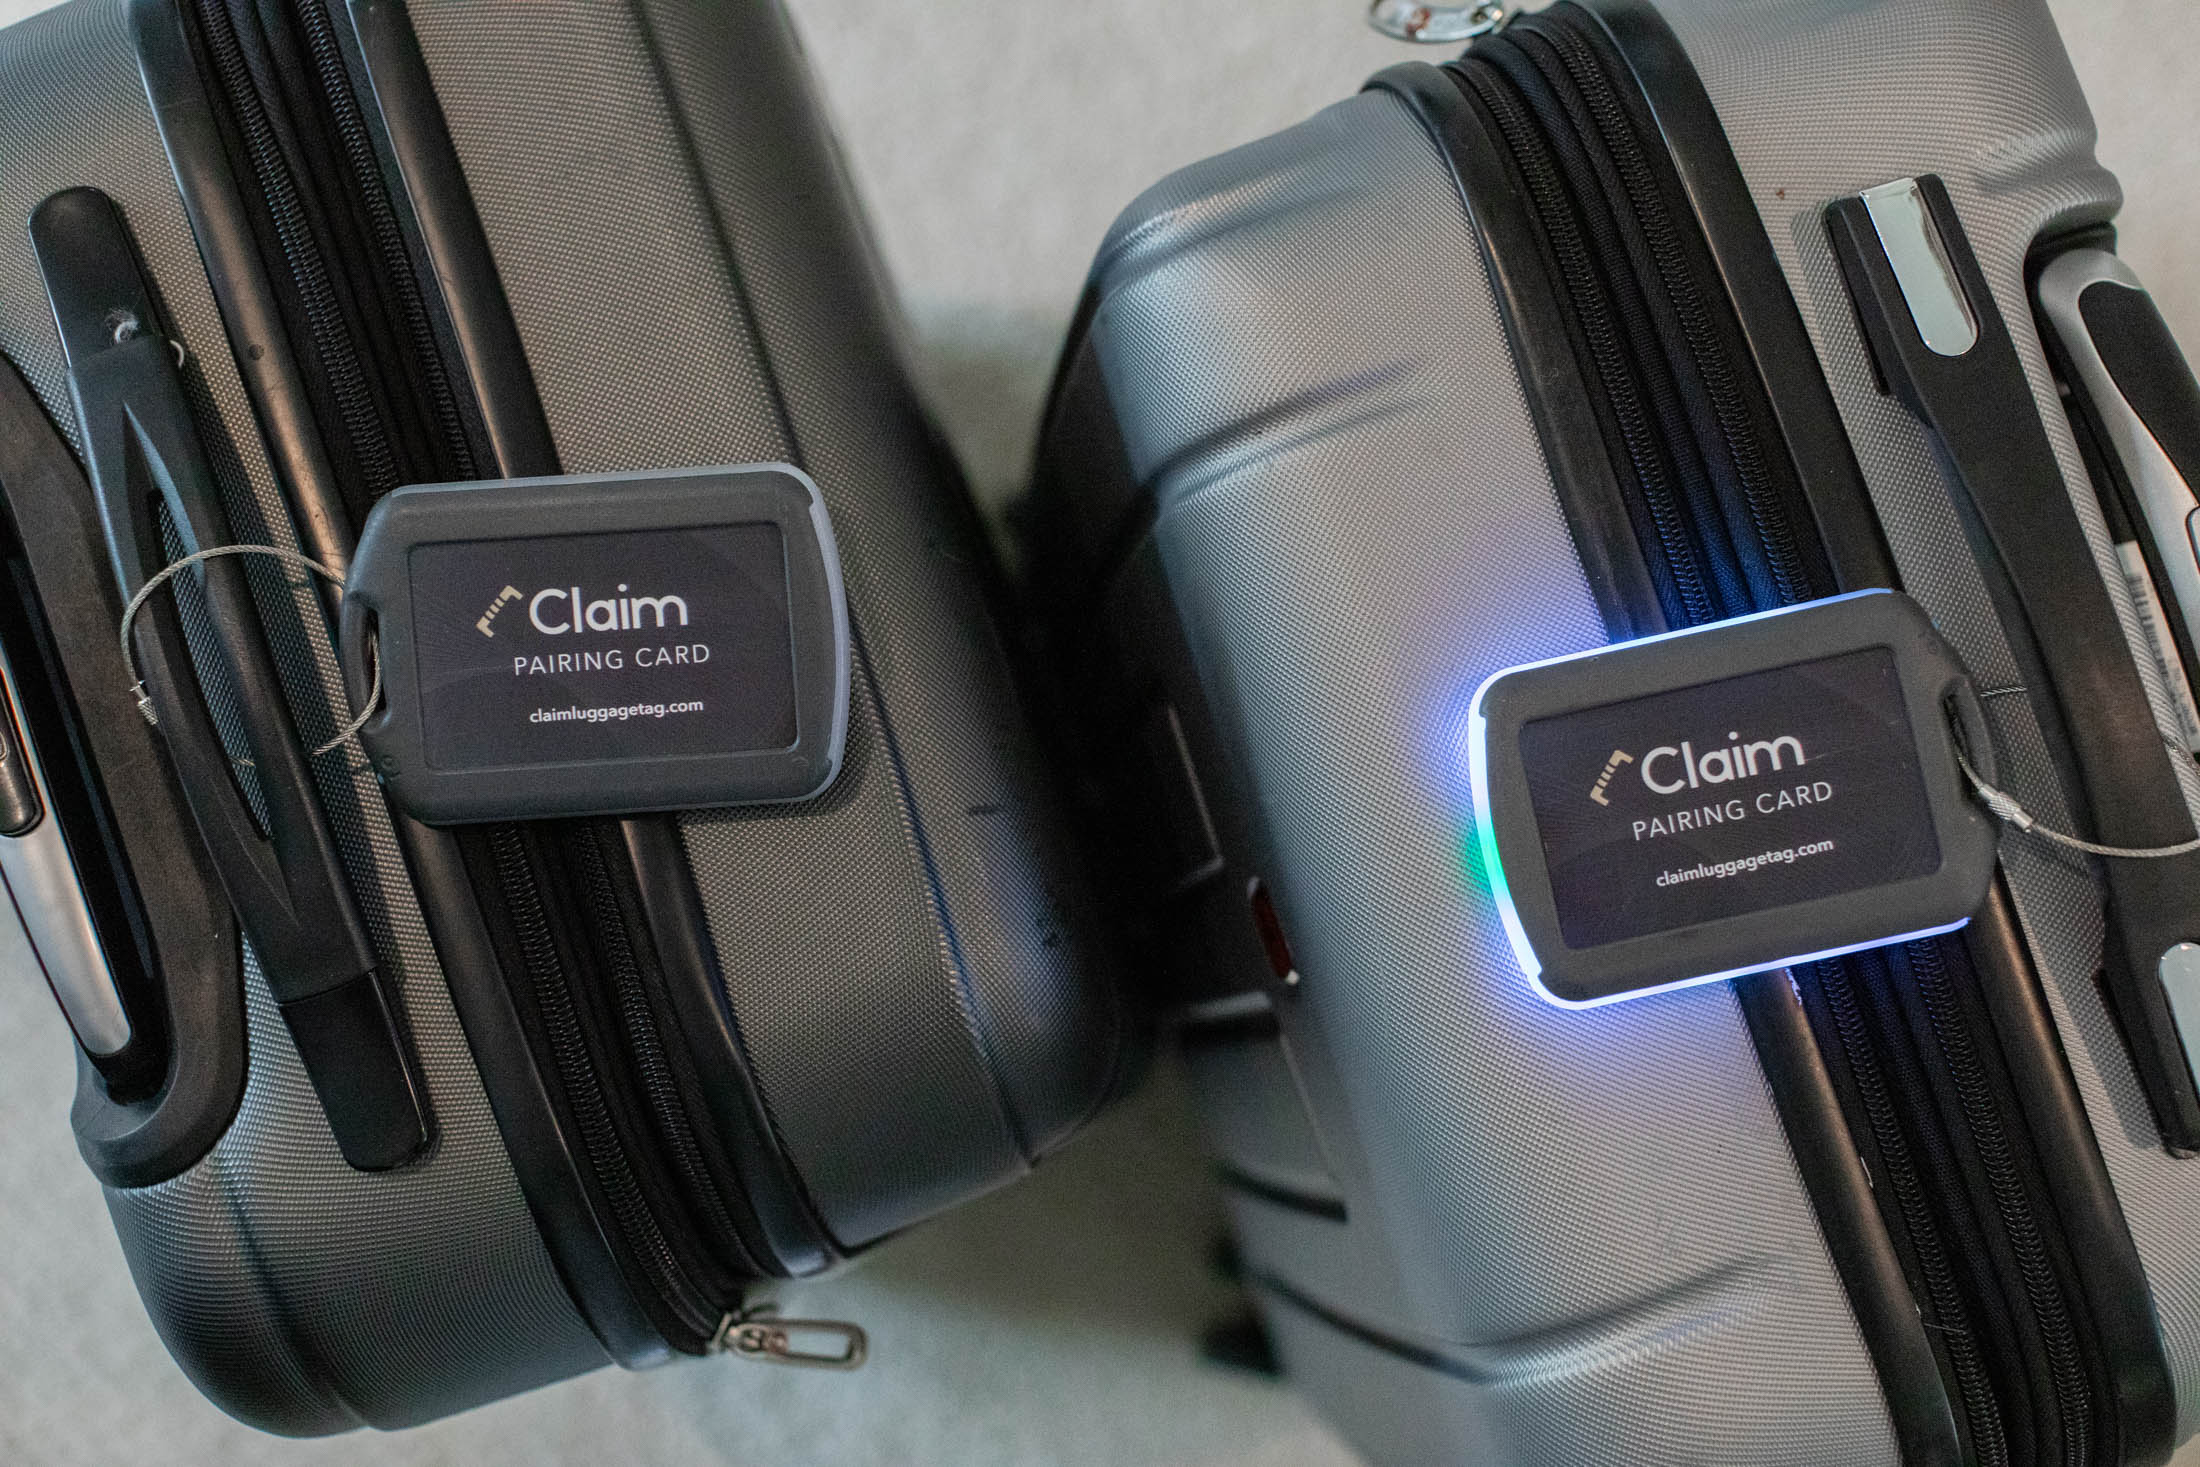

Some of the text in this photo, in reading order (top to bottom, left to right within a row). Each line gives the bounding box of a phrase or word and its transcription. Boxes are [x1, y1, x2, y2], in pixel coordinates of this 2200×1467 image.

[529, 584, 688, 635] Claim
[514, 644, 710, 676] PAIRING CARD
[529, 700, 704, 723] claimluggagetag.com
[1640, 731, 1805, 794] Claim
[1632, 781, 1833, 841] PAIRING CARD
[1656, 839, 1834, 887] claimluggagetag.com
